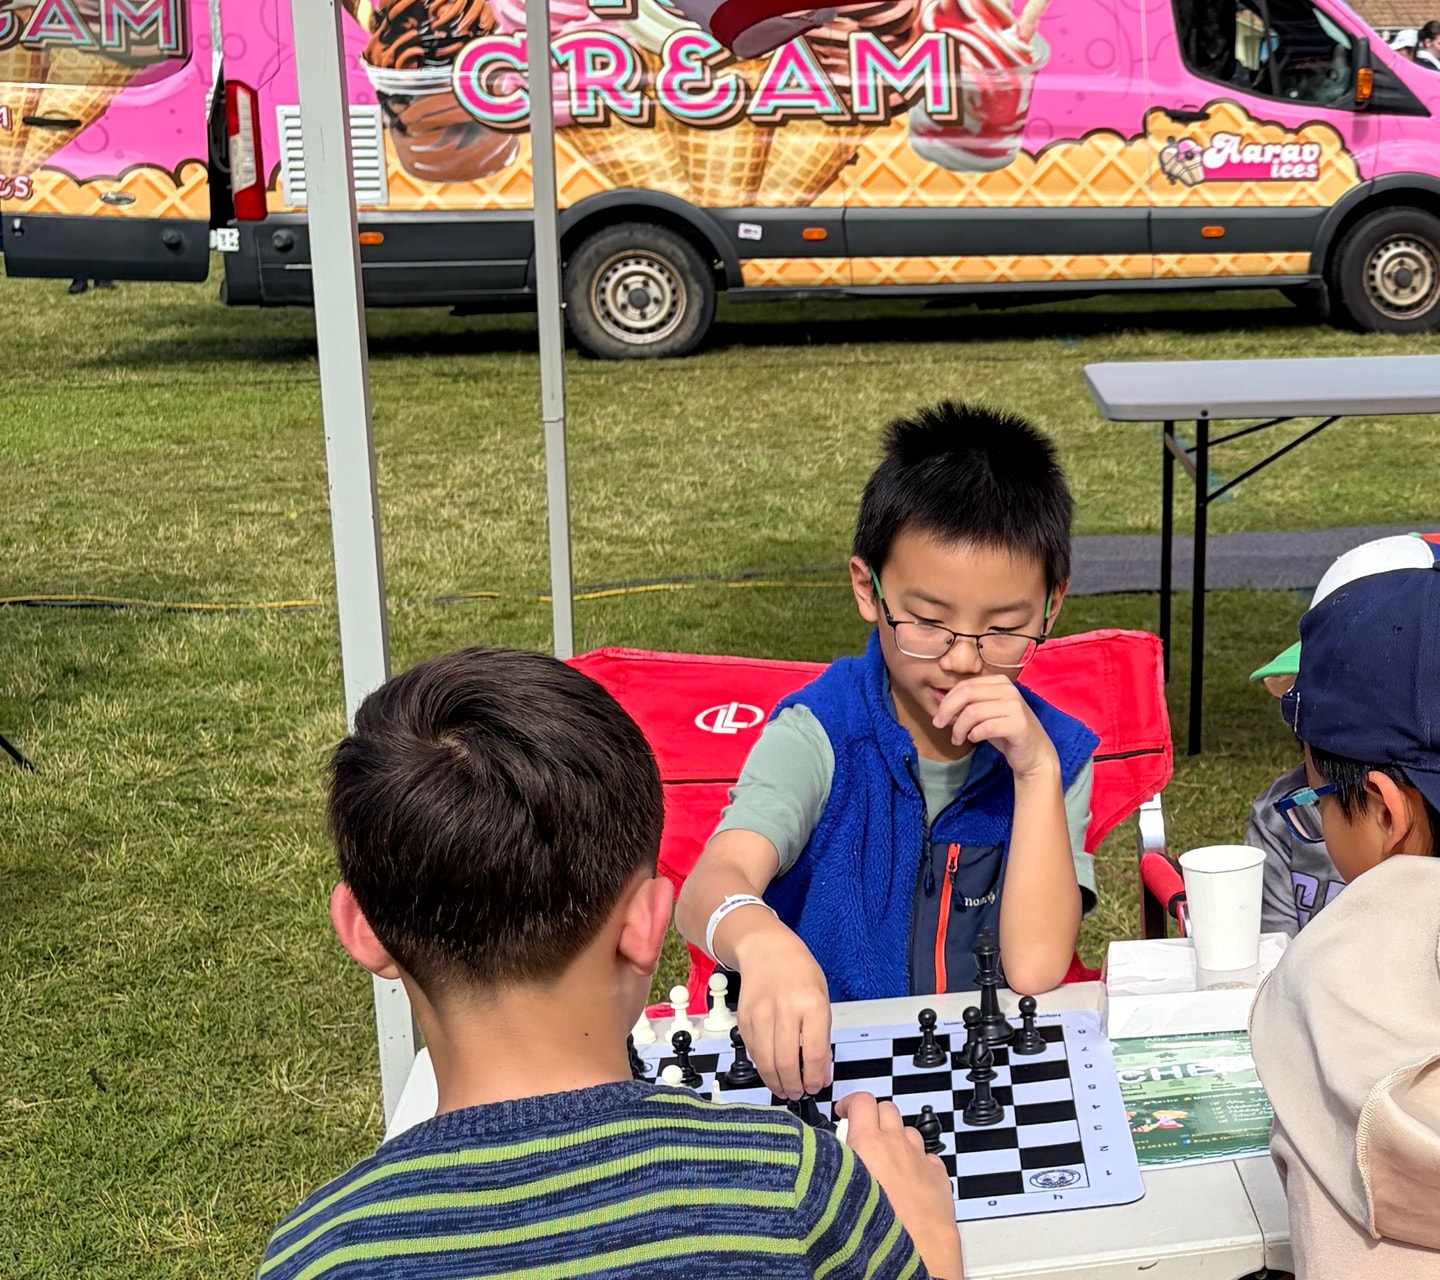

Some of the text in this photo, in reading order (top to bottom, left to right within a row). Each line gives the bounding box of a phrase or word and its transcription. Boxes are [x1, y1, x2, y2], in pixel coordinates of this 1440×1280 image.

[454, 31, 966, 127] CREAM
[1203, 132, 1320, 166] Aarav
[1270, 160, 1319, 179] ices
